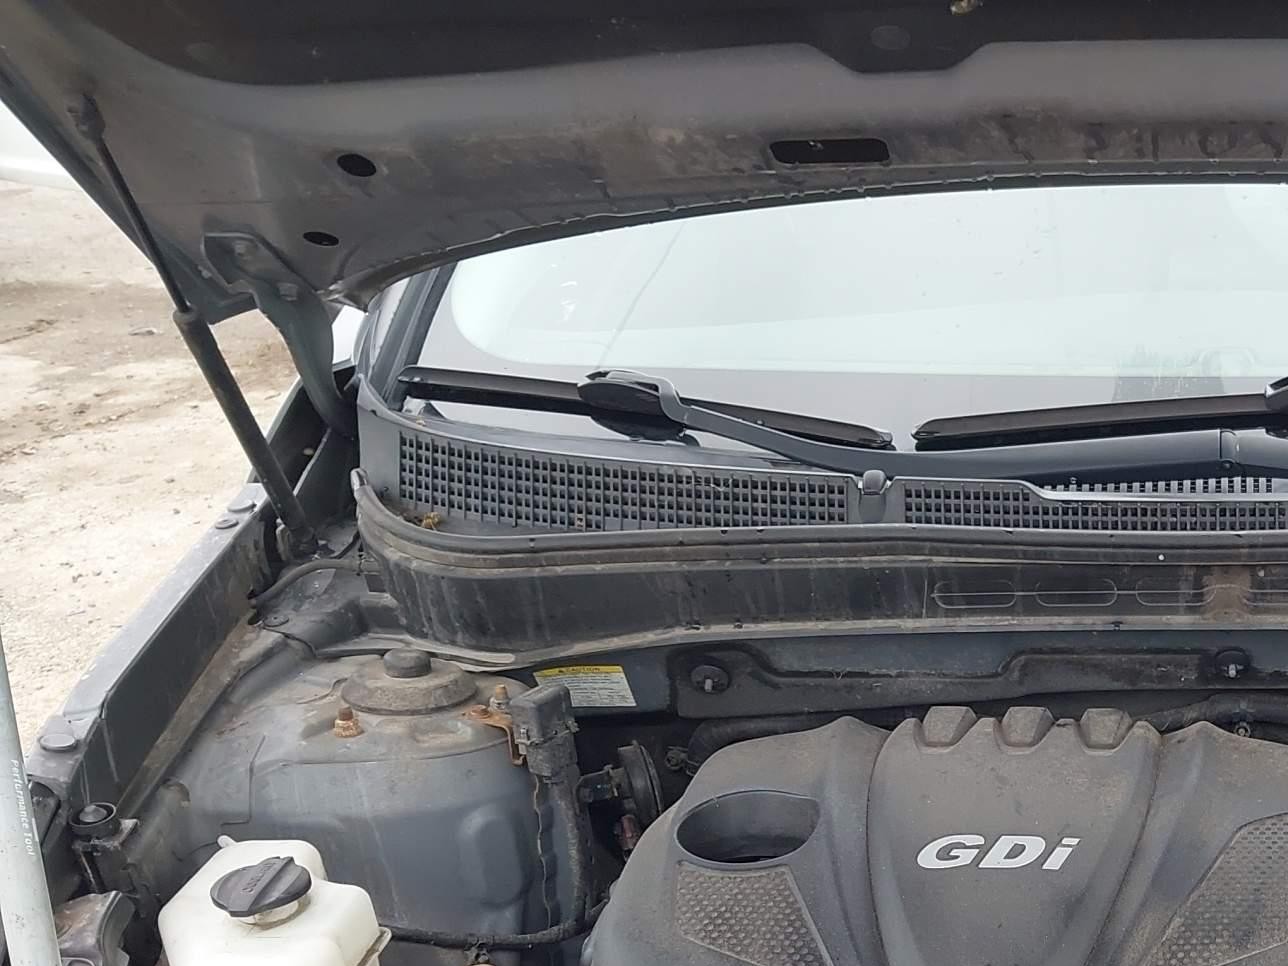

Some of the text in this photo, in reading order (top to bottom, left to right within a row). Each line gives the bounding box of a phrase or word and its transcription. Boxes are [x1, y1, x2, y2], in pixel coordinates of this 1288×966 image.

[11, 760, 35, 856] Performance Tool
[916, 834, 1081, 870] GDi
